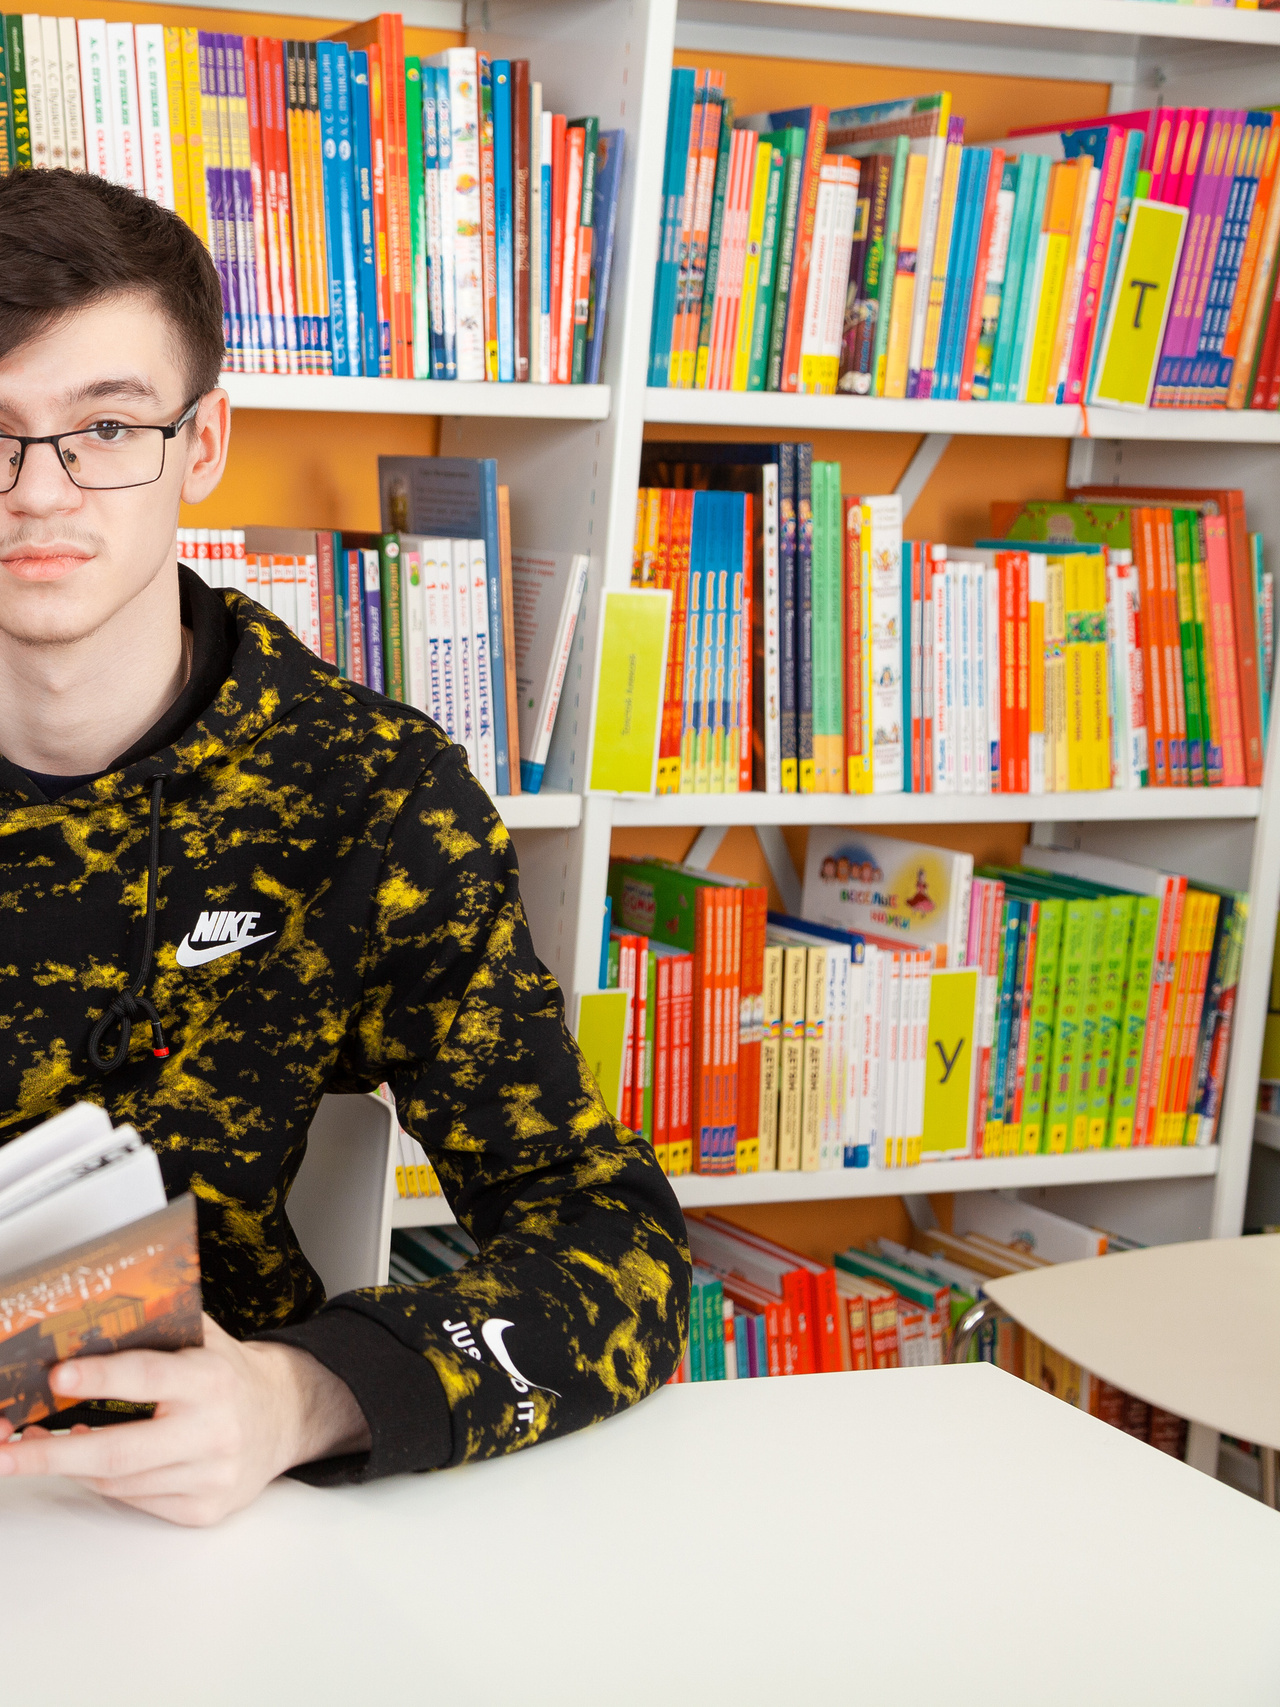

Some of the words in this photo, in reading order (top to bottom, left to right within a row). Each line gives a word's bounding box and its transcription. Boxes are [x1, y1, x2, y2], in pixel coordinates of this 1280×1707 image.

[474, 631, 491, 737] РОДНИЧОК
[191, 911, 261, 942] NIKE
[930, 1034, 964, 1085] У
